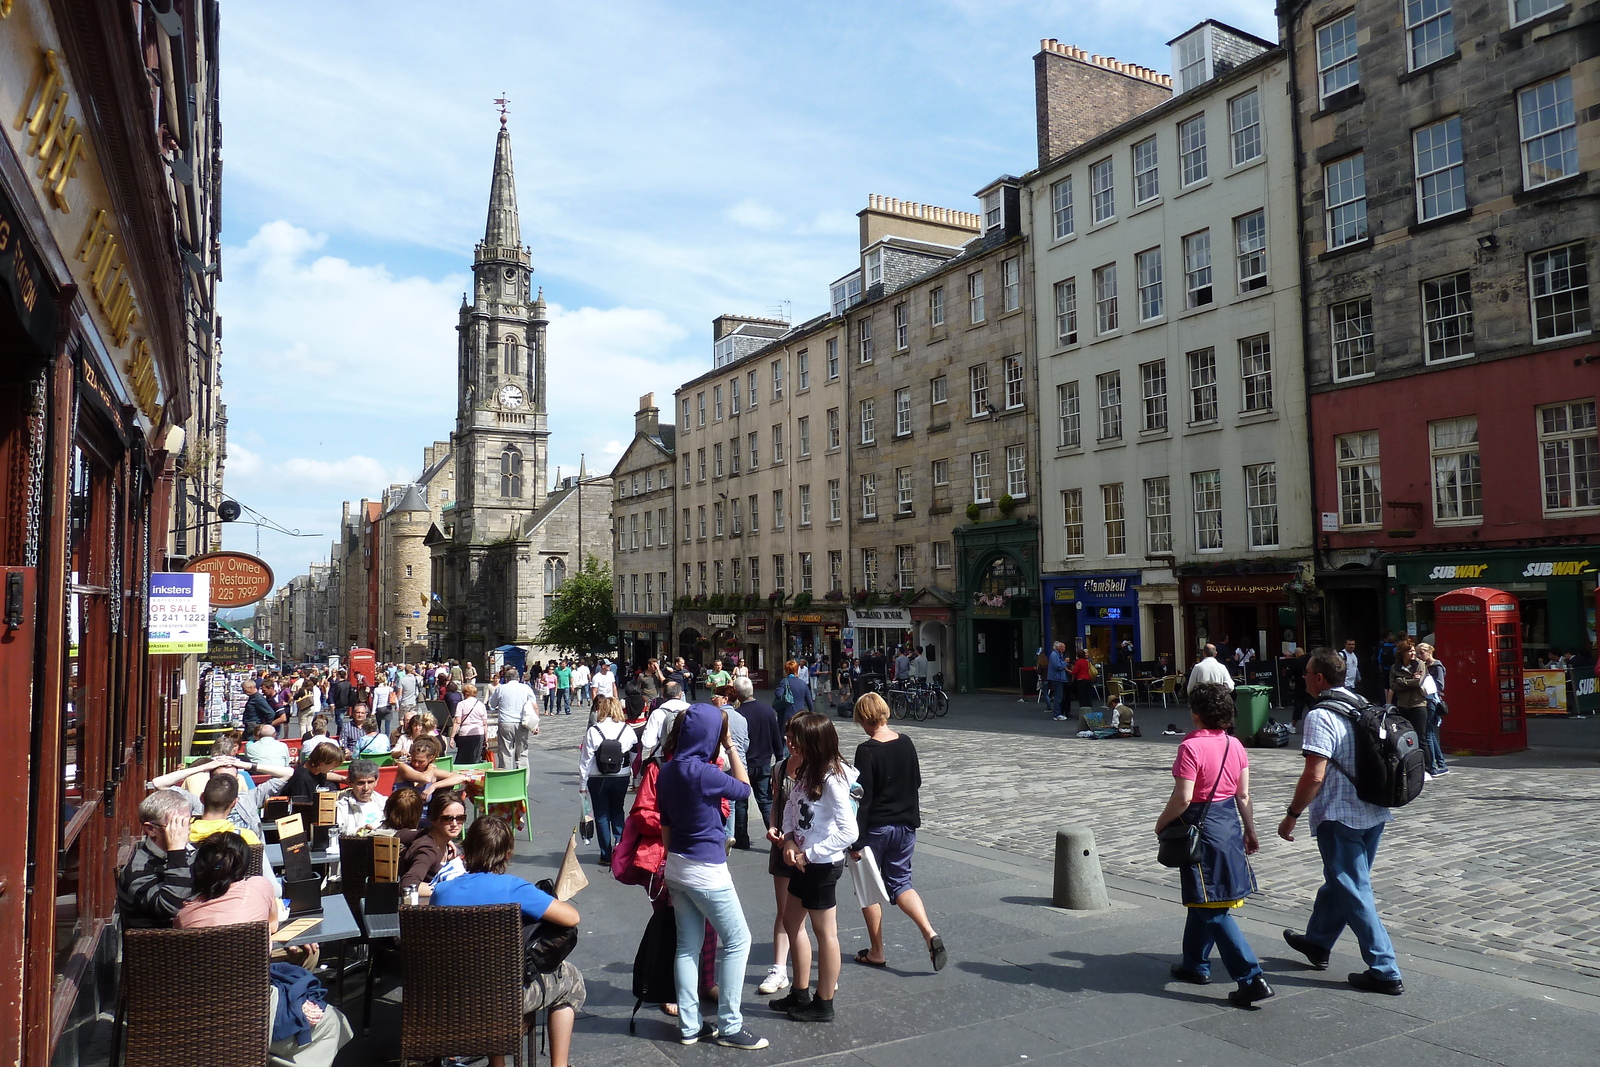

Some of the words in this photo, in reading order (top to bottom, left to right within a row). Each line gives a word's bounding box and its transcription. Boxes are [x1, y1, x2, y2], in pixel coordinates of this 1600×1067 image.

[28, 48, 88, 214] THE
[82, 209, 137, 349] FILLING
[13, 238, 39, 313] STATION
[196, 559, 224, 573] Family
[228, 558, 261, 574] Owned
[1429, 563, 1488, 580] SUBWAY
[1522, 560, 1590, 578] SUBWAY
[219, 573, 266, 586] Restaurant
[152, 585, 192, 595] inksters
[218, 588, 234, 601] 225
[237, 586, 258, 600] 7992
[151, 604, 166, 613] OR
[170, 604, 197, 613] SALE
[162, 614, 179, 622] 241
[184, 614, 206, 622] 1222
